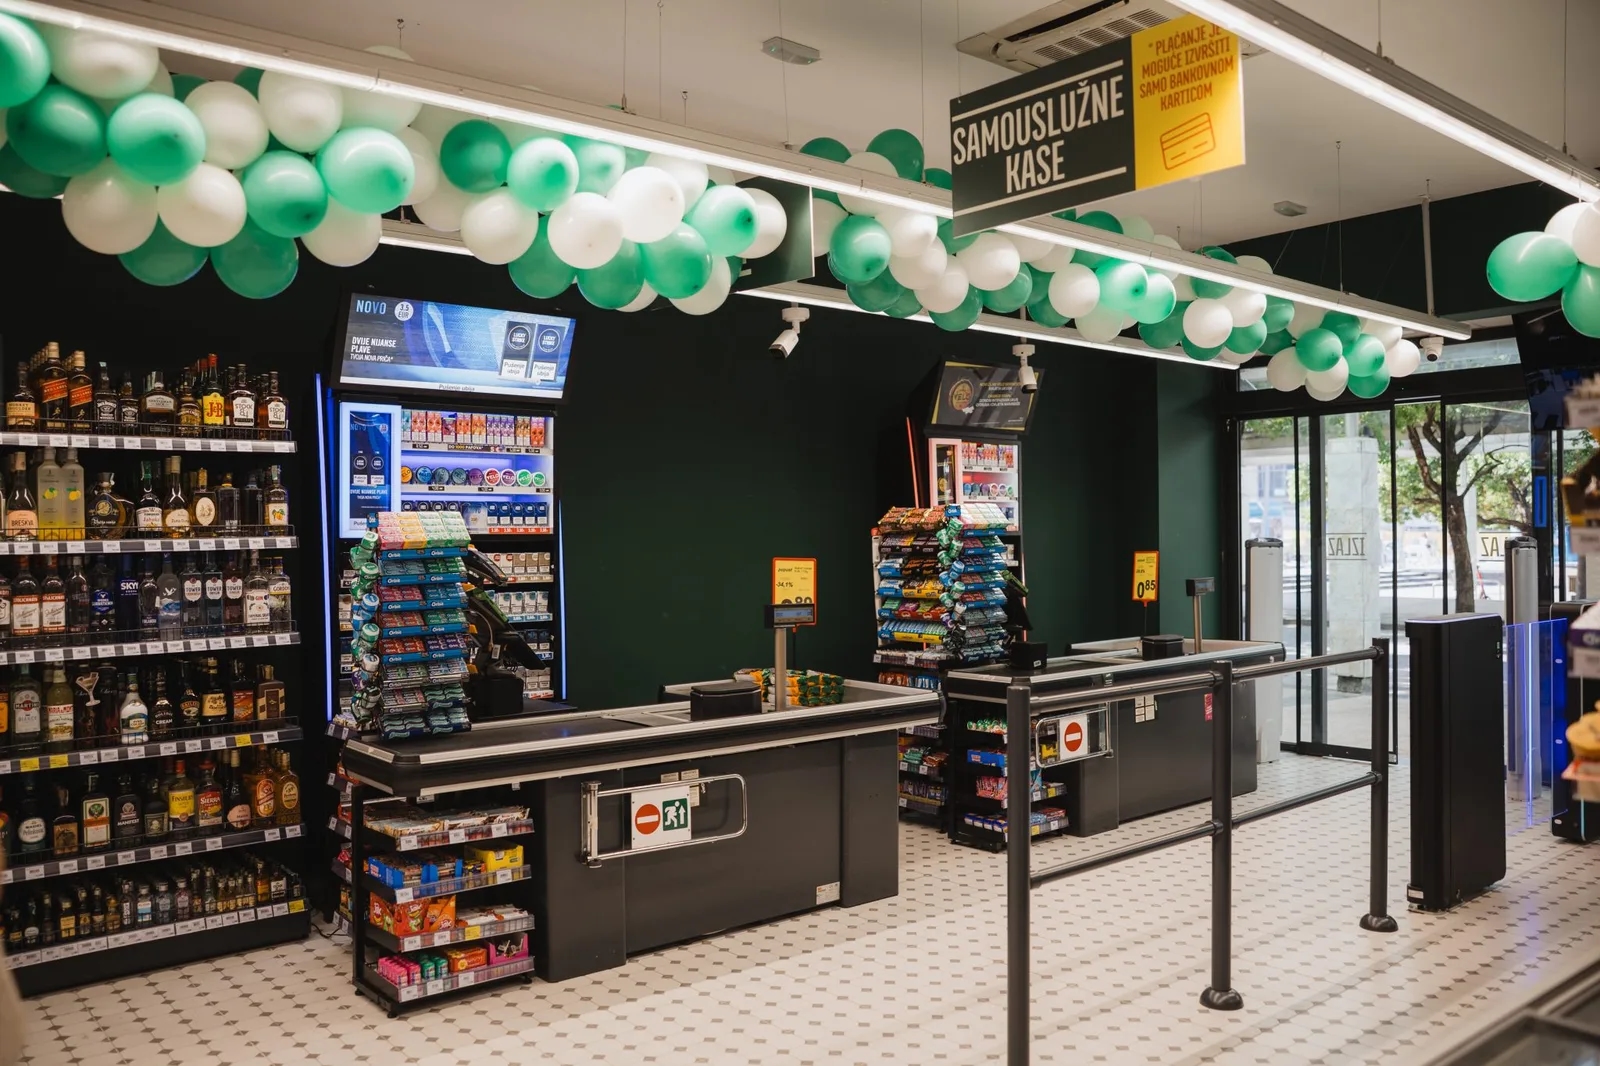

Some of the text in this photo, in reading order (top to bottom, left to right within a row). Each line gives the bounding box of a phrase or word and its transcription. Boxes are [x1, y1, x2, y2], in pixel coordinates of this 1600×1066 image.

[1156, 24, 1206, 56] PLAĆANJE
[1142, 36, 1230, 79] MOGUĆE IZVRŠITI
[1140, 55, 1234, 98] SAMO BANKOVNOM
[1161, 81, 1213, 111] KARTICOM
[953, 75, 1124, 165] SAMOUSLUŽNE
[1006, 140, 1065, 194] KASE
[356, 300, 387, 315] NOVO
[397, 310, 409, 319] EUR
[351, 345, 371, 354] PLAVE
[352, 337, 397, 348] DVIJE NIJANSE
